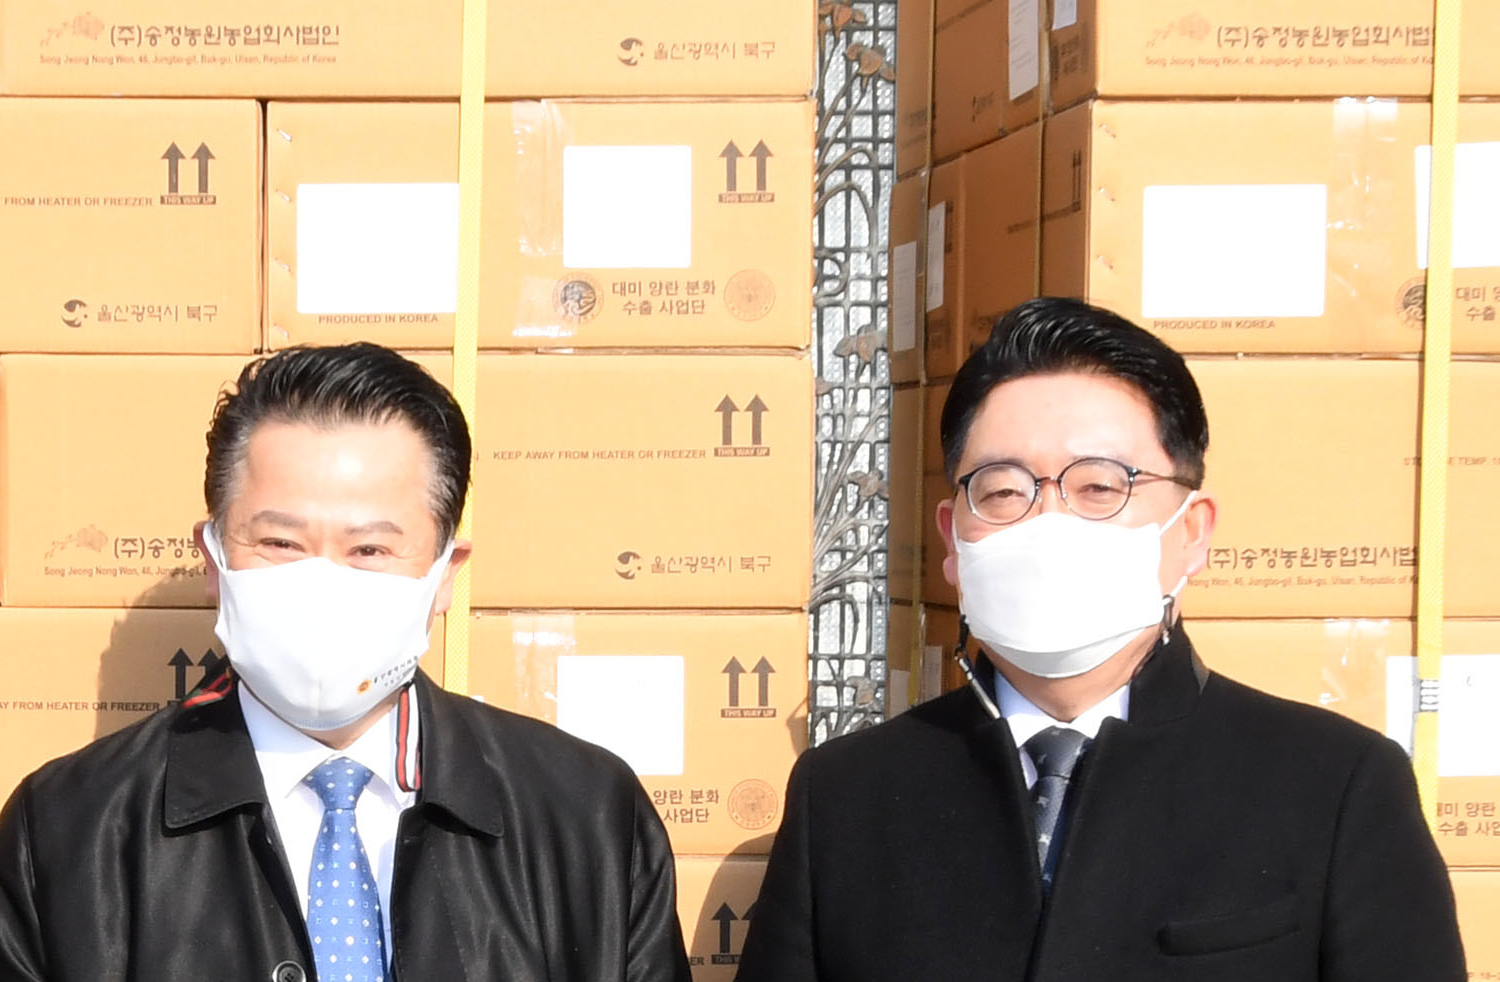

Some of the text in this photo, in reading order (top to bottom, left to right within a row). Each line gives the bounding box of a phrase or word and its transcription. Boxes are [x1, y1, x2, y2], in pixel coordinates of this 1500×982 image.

[110, 25, 339, 46] (주)송정농원농업회사법인
[1217, 26, 1431, 48] (주)송정농원농업회사법
[654, 42, 775, 60] 울산광역시 북구
[4, 196, 35, 206] FROM
[38, 196, 81, 206] HEATER
[84, 196, 100, 206] OR
[104, 196, 153, 206] FREEZER
[612, 280, 716, 296] 대미 양란 분화
[98, 305, 218, 323] 울산광역시 북구
[622, 300, 705, 316] 수출 사업단
[318, 314, 438, 324] PRODUCED IN KOREA
[1154, 319, 1276, 329] PRODUCED IN KOREA
[493, 450, 706, 460] KEEP AWAY FROM HEATER OR FREEZER
[652, 556, 771, 574] 울산광역시 북구
[1206, 547, 1417, 569] (주)송정농원농업회사법
[13, 701, 44, 711] FROM
[47, 701, 88, 711] HEATER
[92, 701, 108, 711] OR
[111, 701, 160, 711] FREEZER
[653, 789, 719, 805] 양란 분화
[664, 808, 710, 823] 사업단
